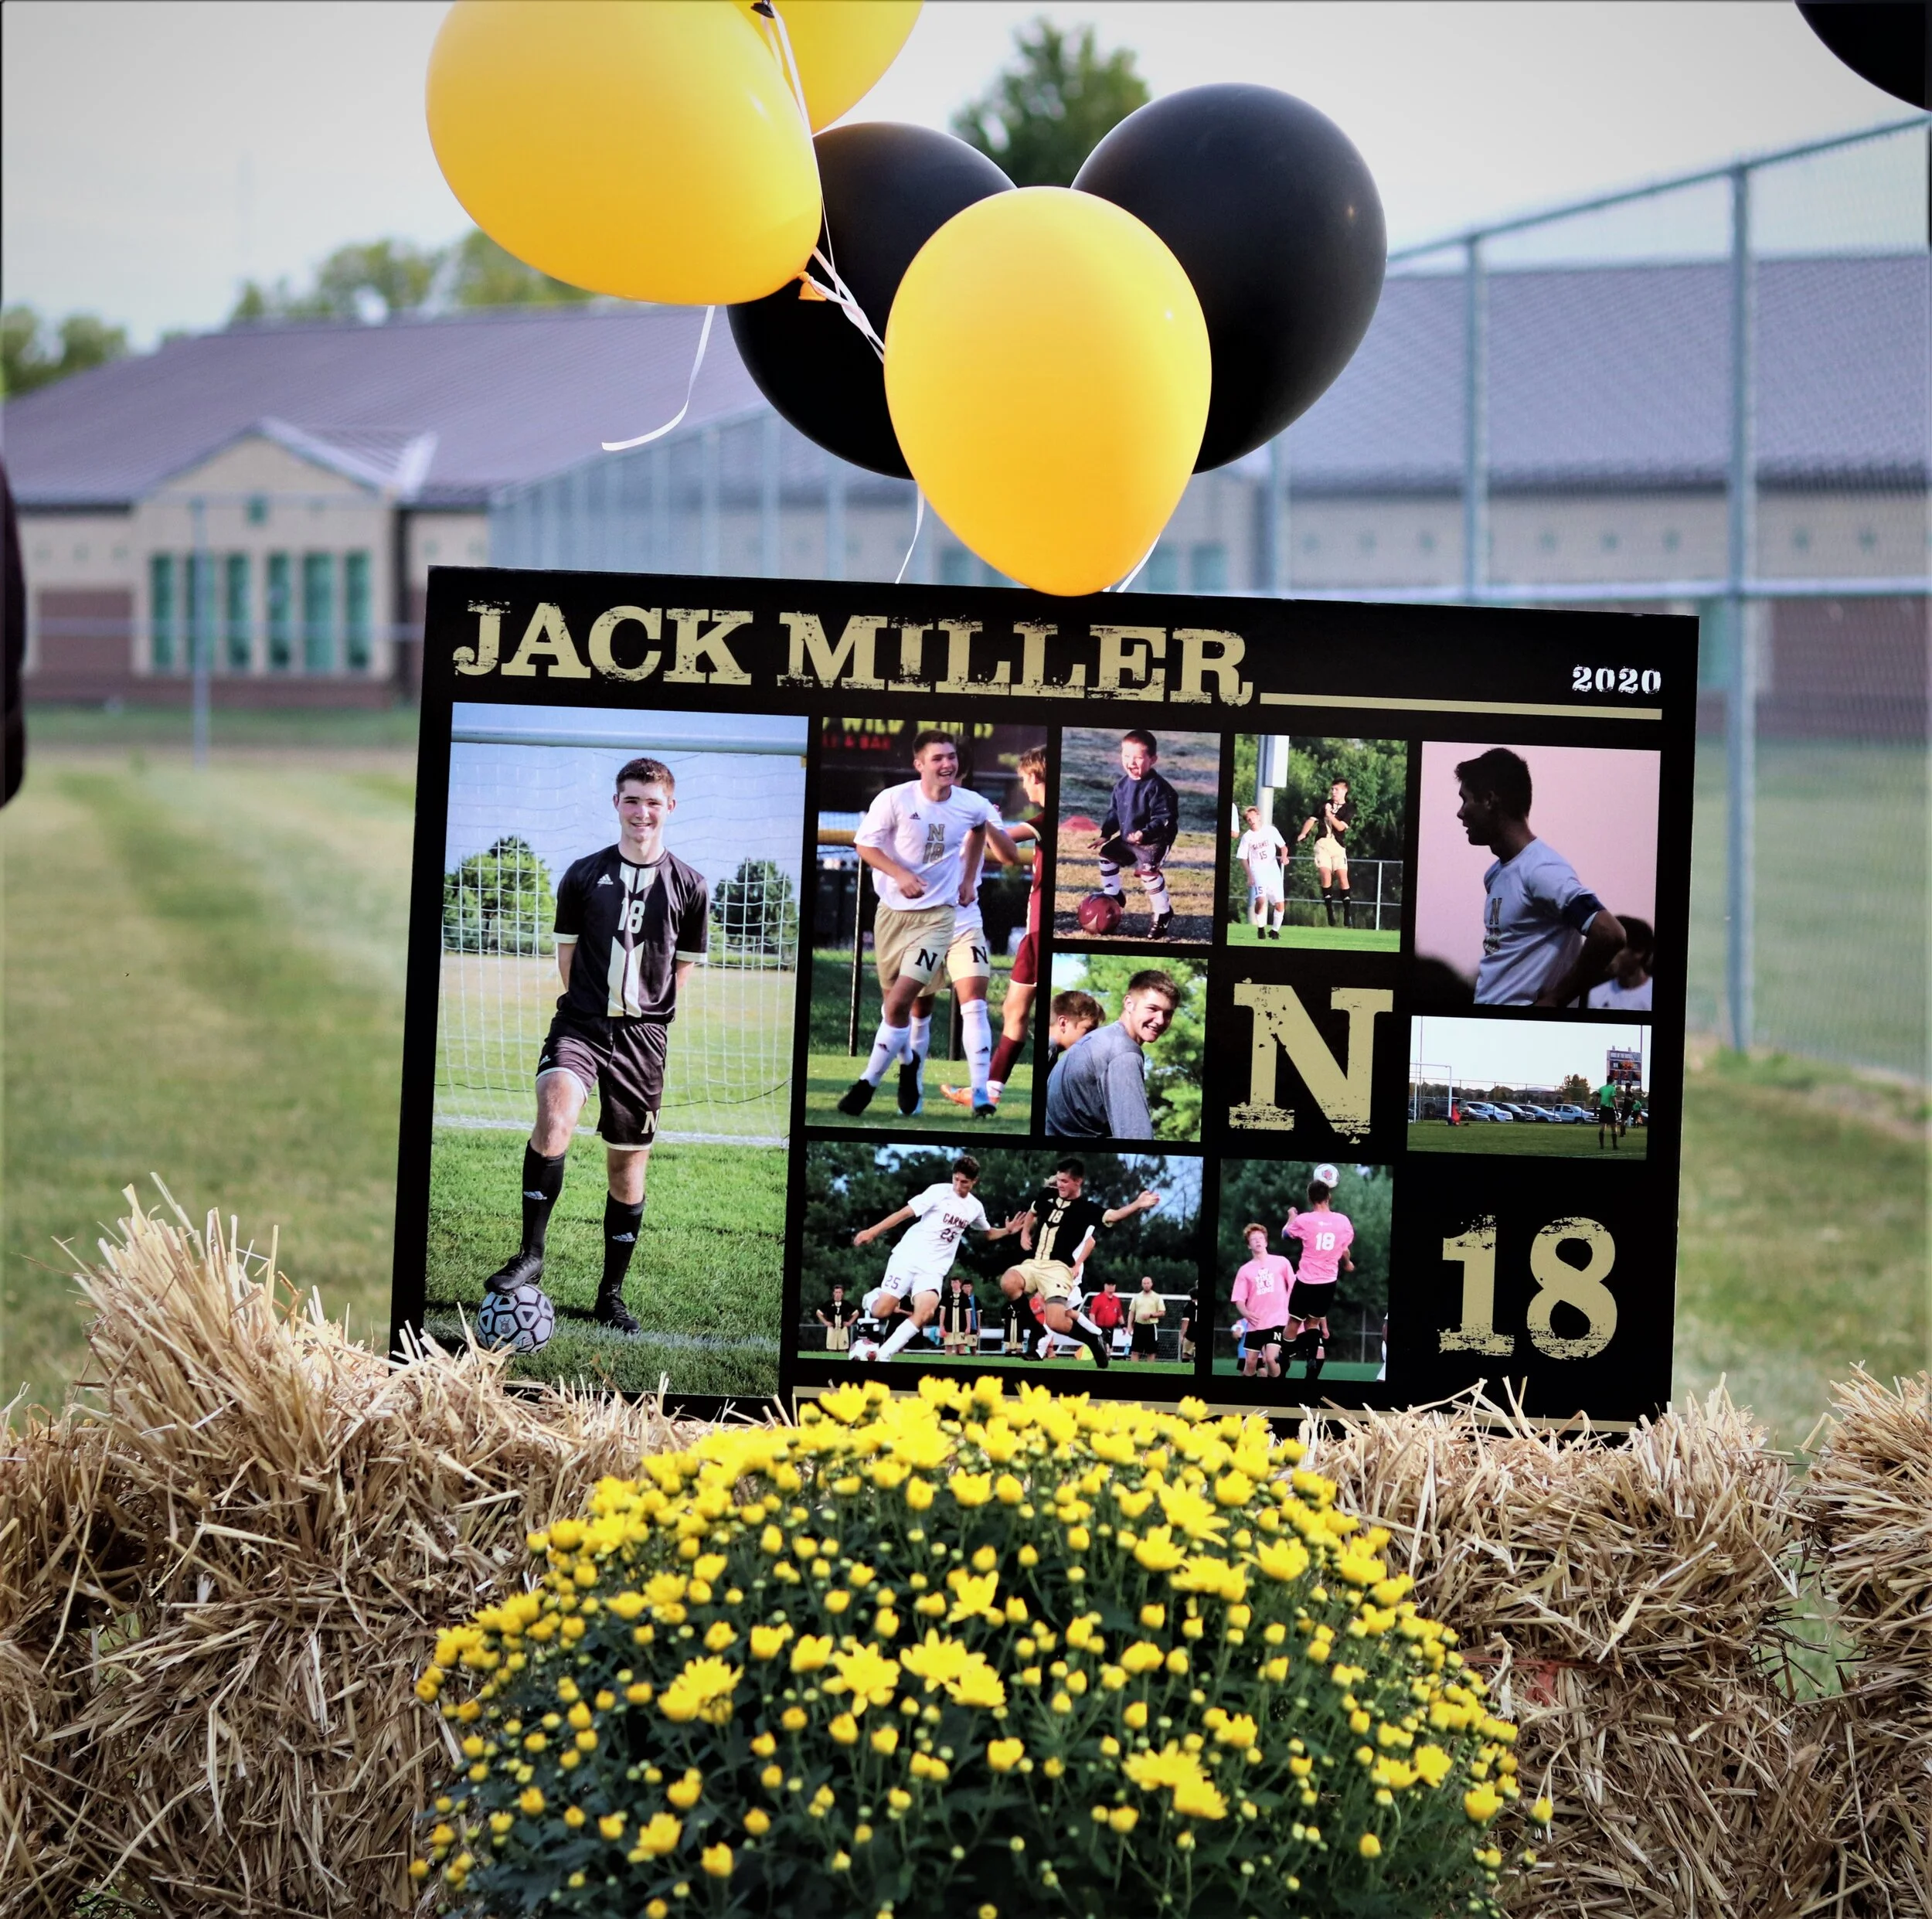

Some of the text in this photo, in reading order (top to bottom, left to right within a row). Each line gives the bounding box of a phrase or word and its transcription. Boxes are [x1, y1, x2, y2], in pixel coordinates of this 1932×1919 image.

[453, 600, 1253, 706] JACK MILLER
[1572, 665, 1662, 694] 2020
[927, 823, 945, 841] N
[617, 897, 645, 934] 18
[1489, 897, 1502, 925] N
[915, 948, 938, 971] N
[970, 945, 988, 965] N
[1228, 978, 1394, 1144] N
[641, 1108, 660, 1134] N
[1048, 1208, 1064, 1224] 18
[940, 1228, 958, 1243] 25
[1315, 1232, 1335, 1251] 18
[884, 1274, 902, 1290] 25
[1437, 1214, 1618, 1360] 18
[1273, 1331, 1282, 1342] N
